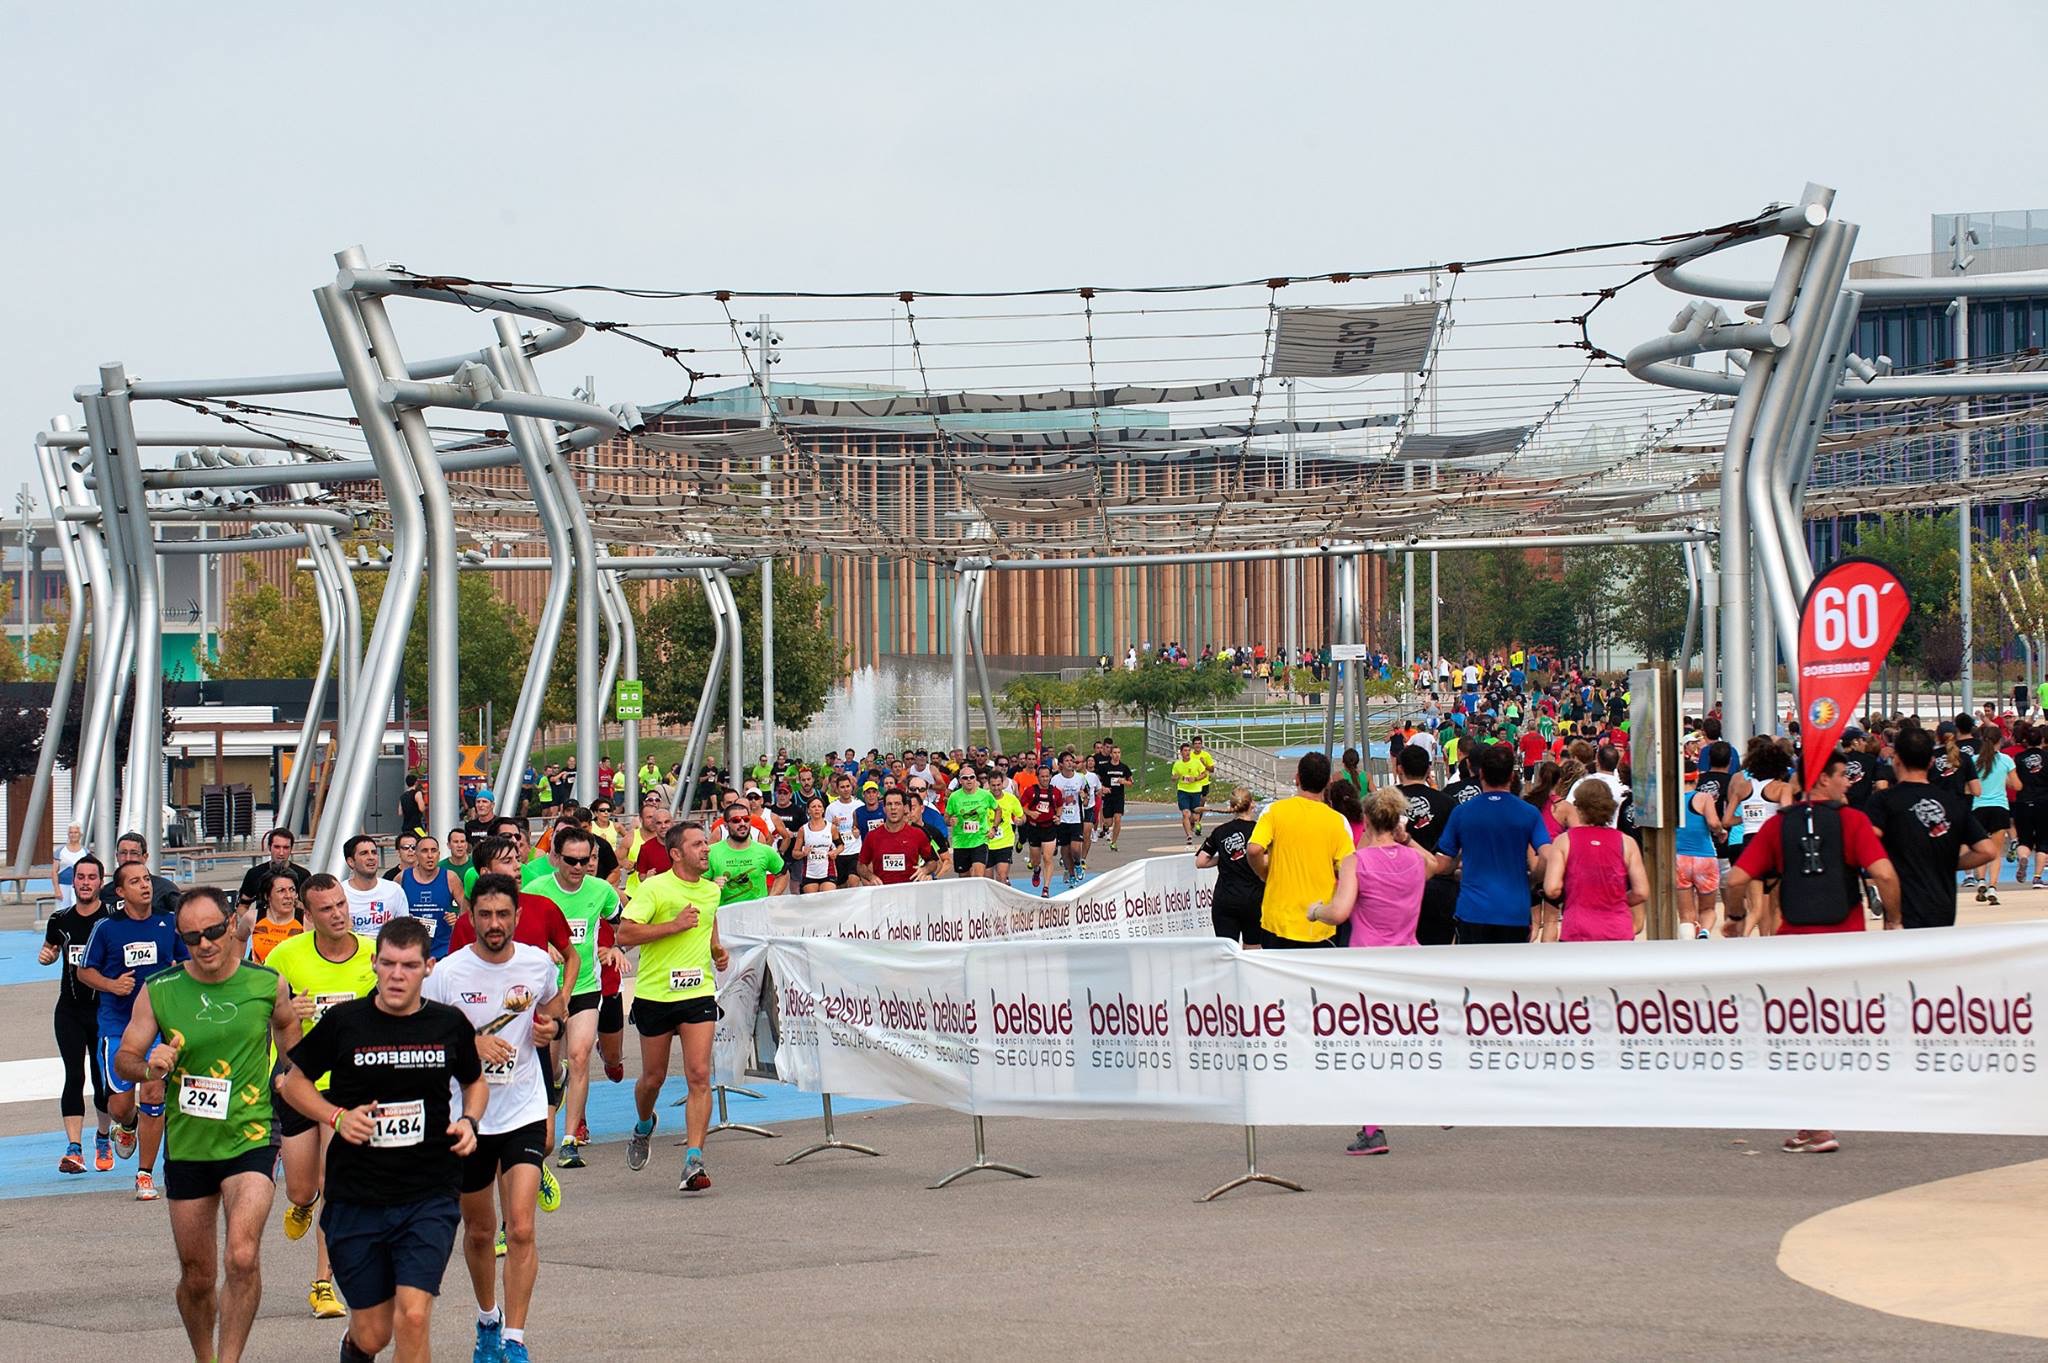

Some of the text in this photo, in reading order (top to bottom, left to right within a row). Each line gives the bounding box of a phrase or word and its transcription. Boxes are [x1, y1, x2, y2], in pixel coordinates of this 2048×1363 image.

[131, 950, 151, 961] 704
[673, 977, 701, 989] 1420
[928, 987, 977, 1035] belsué
[990, 987, 1073, 1035] belsué
[1087, 987, 1169, 1036] belsué
[1184, 988, 1285, 1037] belsué
[1310, 986, 1439, 1036] belsué
[1463, 986, 1592, 1036] belsué
[1609, 986, 1739, 1035] belsué
[1756, 983, 1885, 1035] belsué
[1908, 980, 2033, 1035] belsué
[995, 1050, 1075, 1067] SEGUROS
[1092, 1051, 1172, 1069] SEGUROS
[1189, 1052, 1288, 1071] SEGUROS
[1315, 1052, 1443, 1070] SEGUROS
[1469, 1051, 1595, 1070] SEGUROS
[1620, 1051, 1744, 1070] SEGUROS
[1768, 1052, 1891, 1071] SEGUROS
[1915, 1052, 2036, 1073] SEGUROS
[187, 1090, 218, 1109] 294
[376, 1117, 421, 1137] 1484
